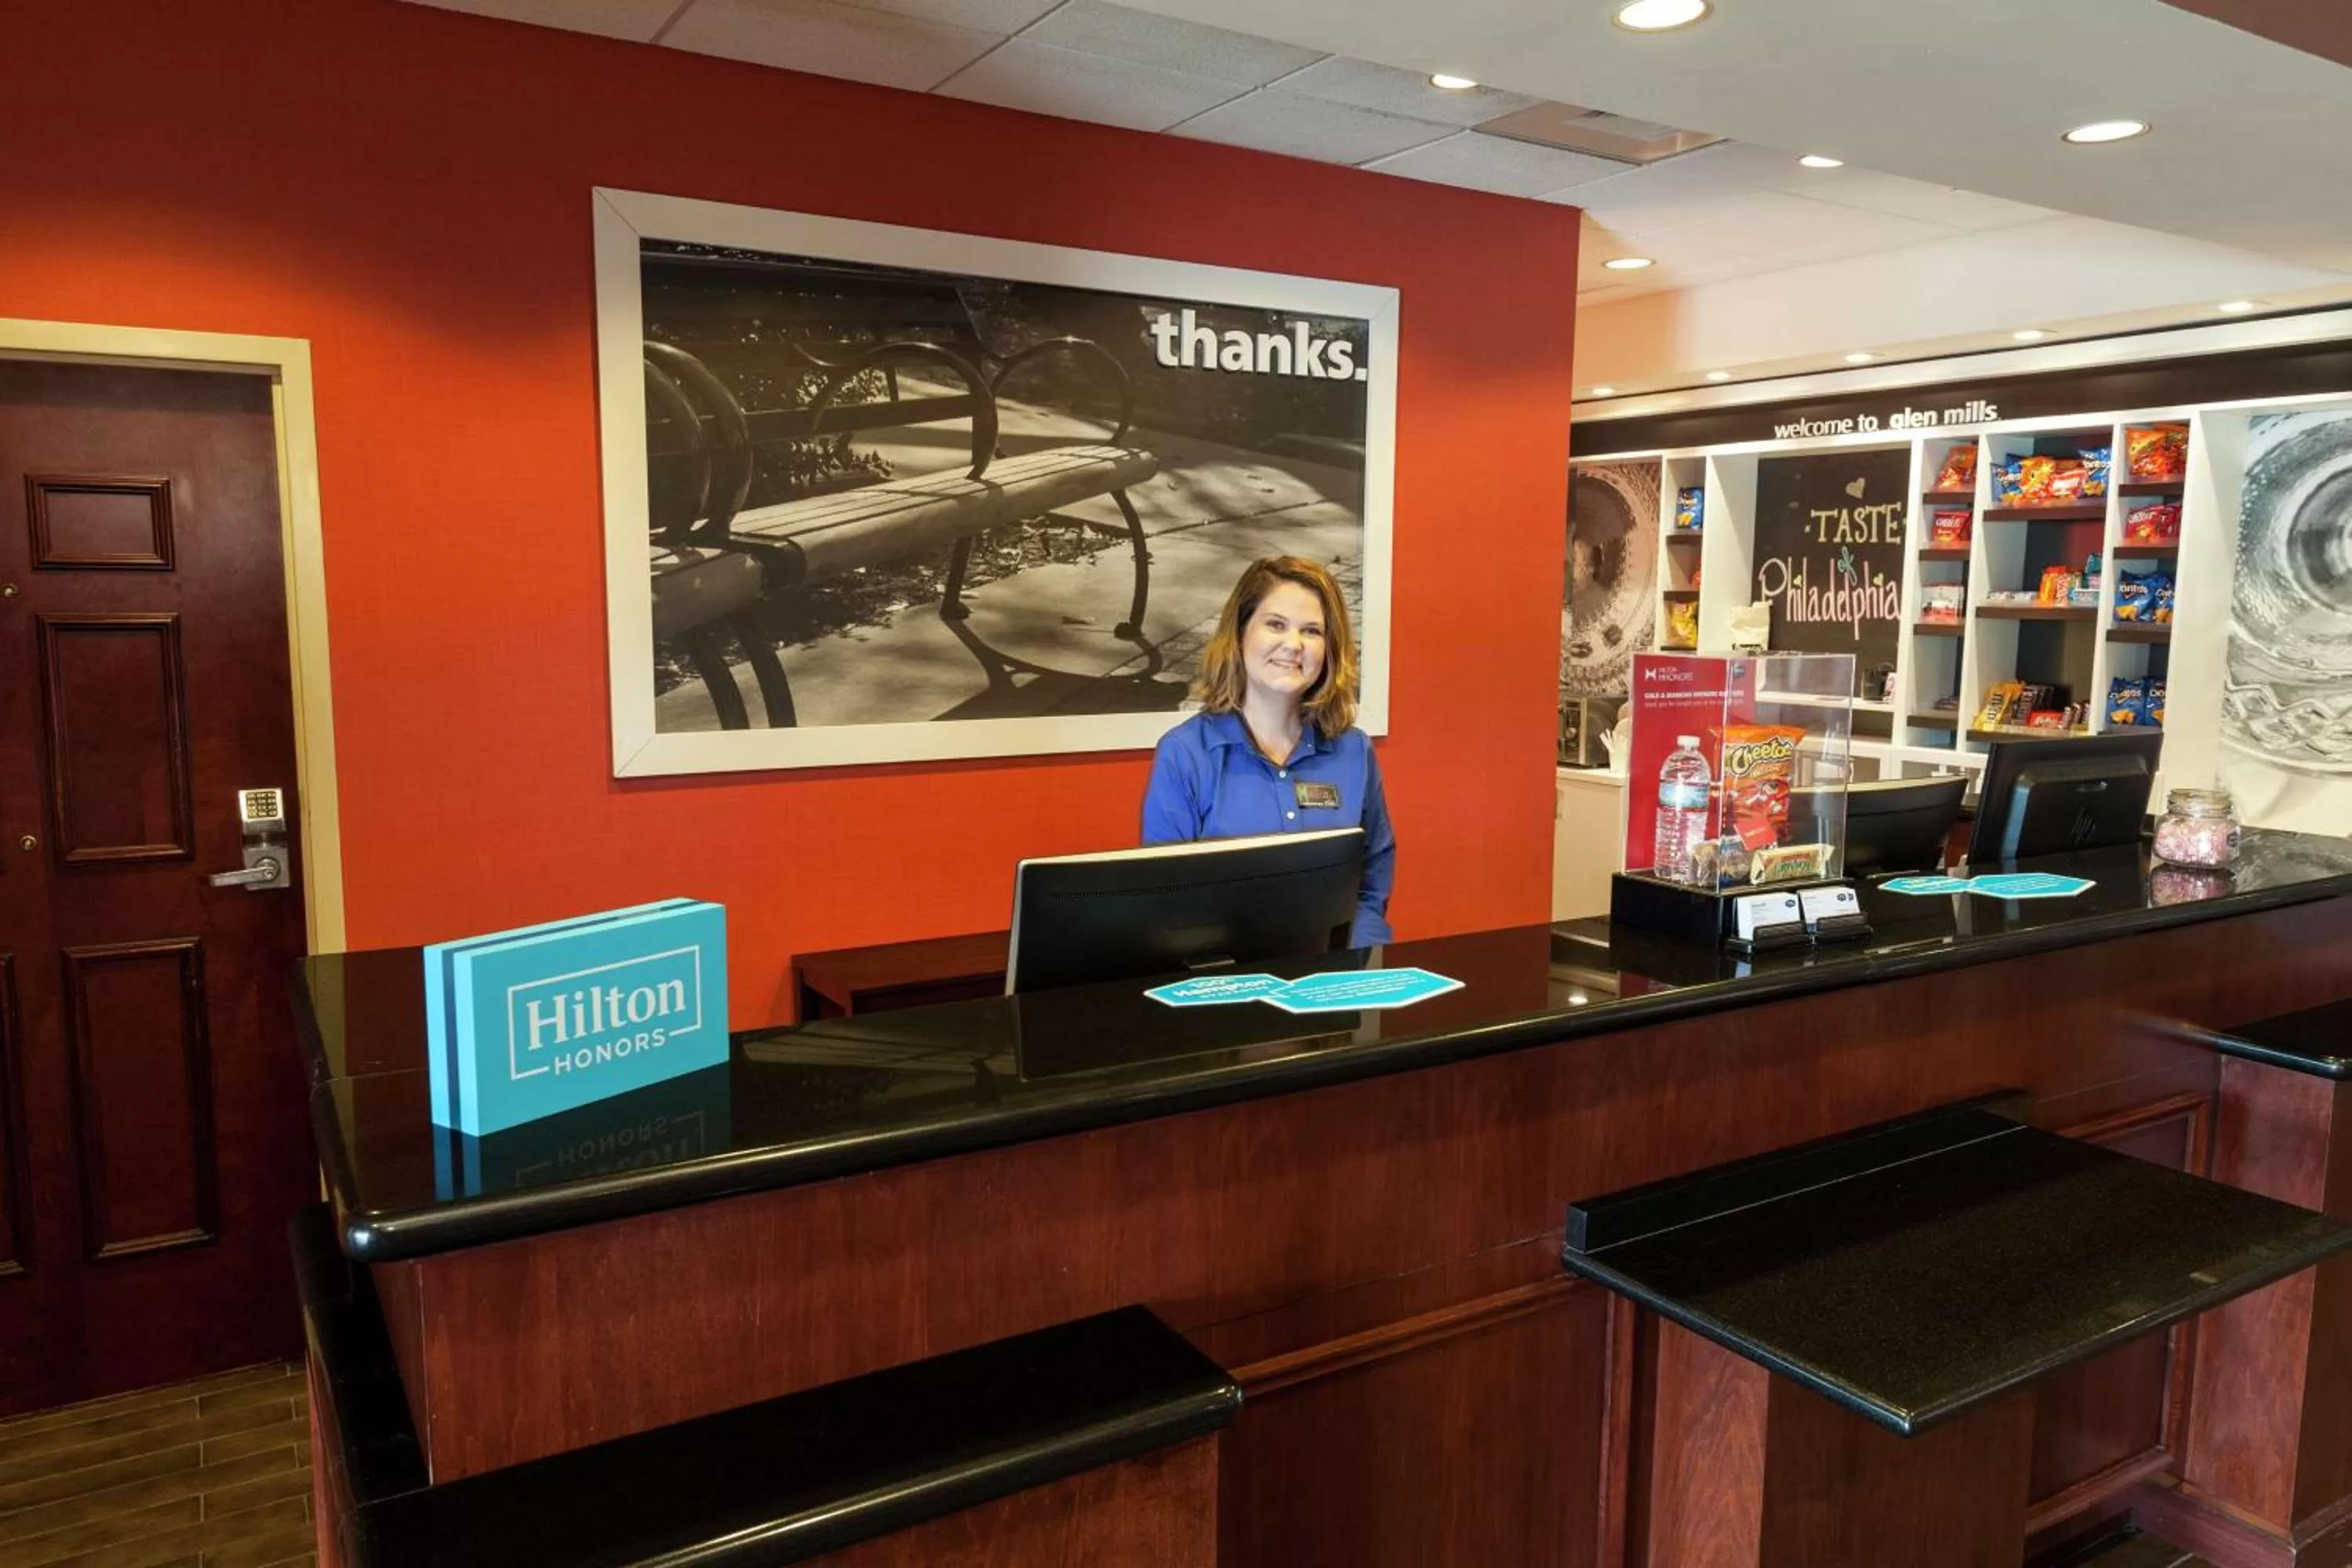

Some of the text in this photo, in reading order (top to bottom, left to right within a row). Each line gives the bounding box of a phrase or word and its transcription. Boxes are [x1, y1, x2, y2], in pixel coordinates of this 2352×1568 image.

[1150, 308, 1368, 381] thanks.
[1774, 417, 1853, 439] welcome
[1858, 414, 1879, 431] to
[1811, 502, 1902, 545] TASTE
[1759, 557, 1903, 641] Philadelphia
[527, 979, 686, 1051] Hilton
[554, 1029, 666, 1075] HONORS
